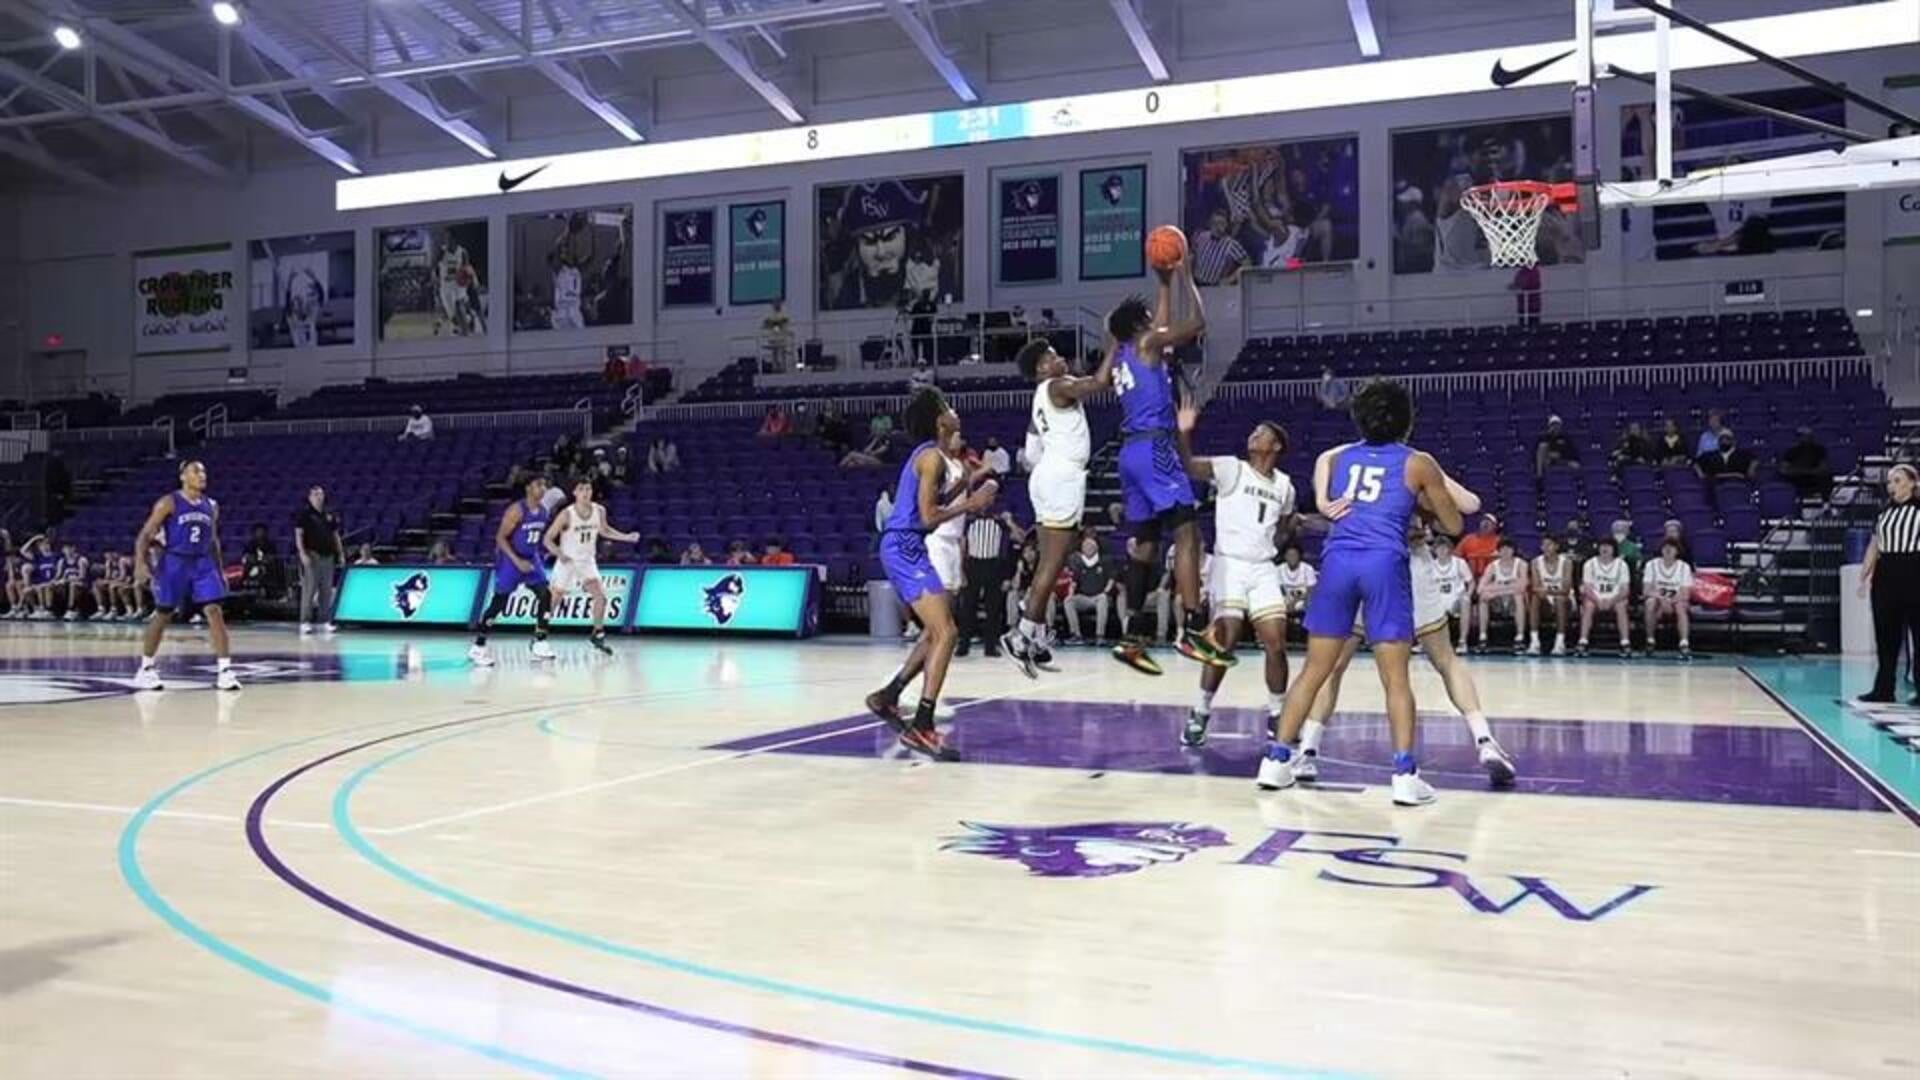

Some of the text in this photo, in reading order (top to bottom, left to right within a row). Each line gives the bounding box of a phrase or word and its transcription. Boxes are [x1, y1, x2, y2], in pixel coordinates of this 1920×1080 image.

[1145, 91, 1160, 113] 0
[807, 129, 819, 150] 8
[861, 195, 889, 218] FSW
[146, 293, 223, 317] ROOFING
[1347, 463, 1386, 503] 15
[1258, 501, 1267, 524] 1
[189, 526, 201, 543] 2
[1230, 829, 1661, 922] FSW
